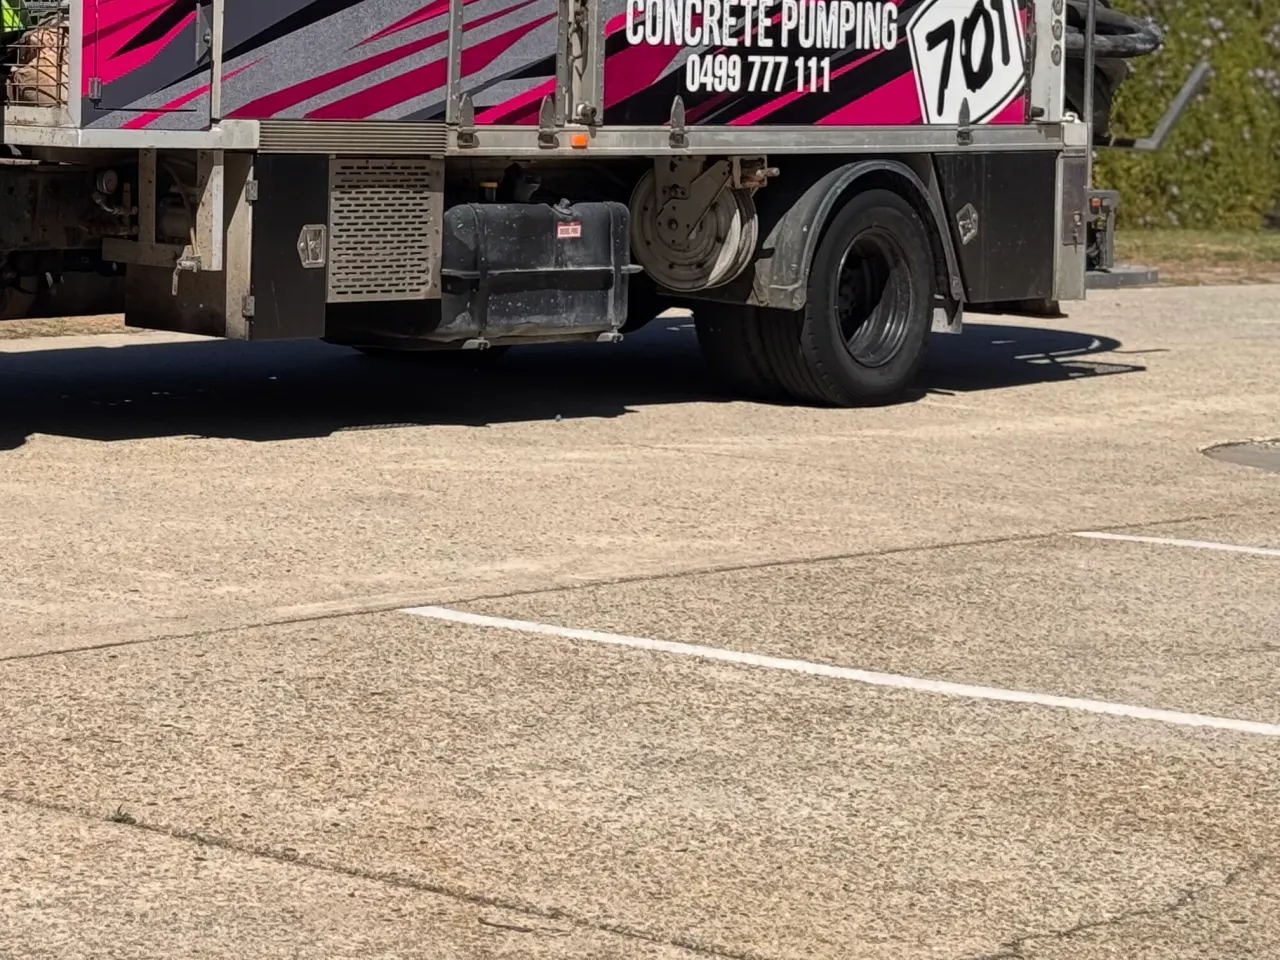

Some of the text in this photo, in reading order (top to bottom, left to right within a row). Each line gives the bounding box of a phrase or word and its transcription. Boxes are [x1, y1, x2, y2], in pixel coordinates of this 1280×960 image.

[685, 54, 831, 93] 0499 777 111
